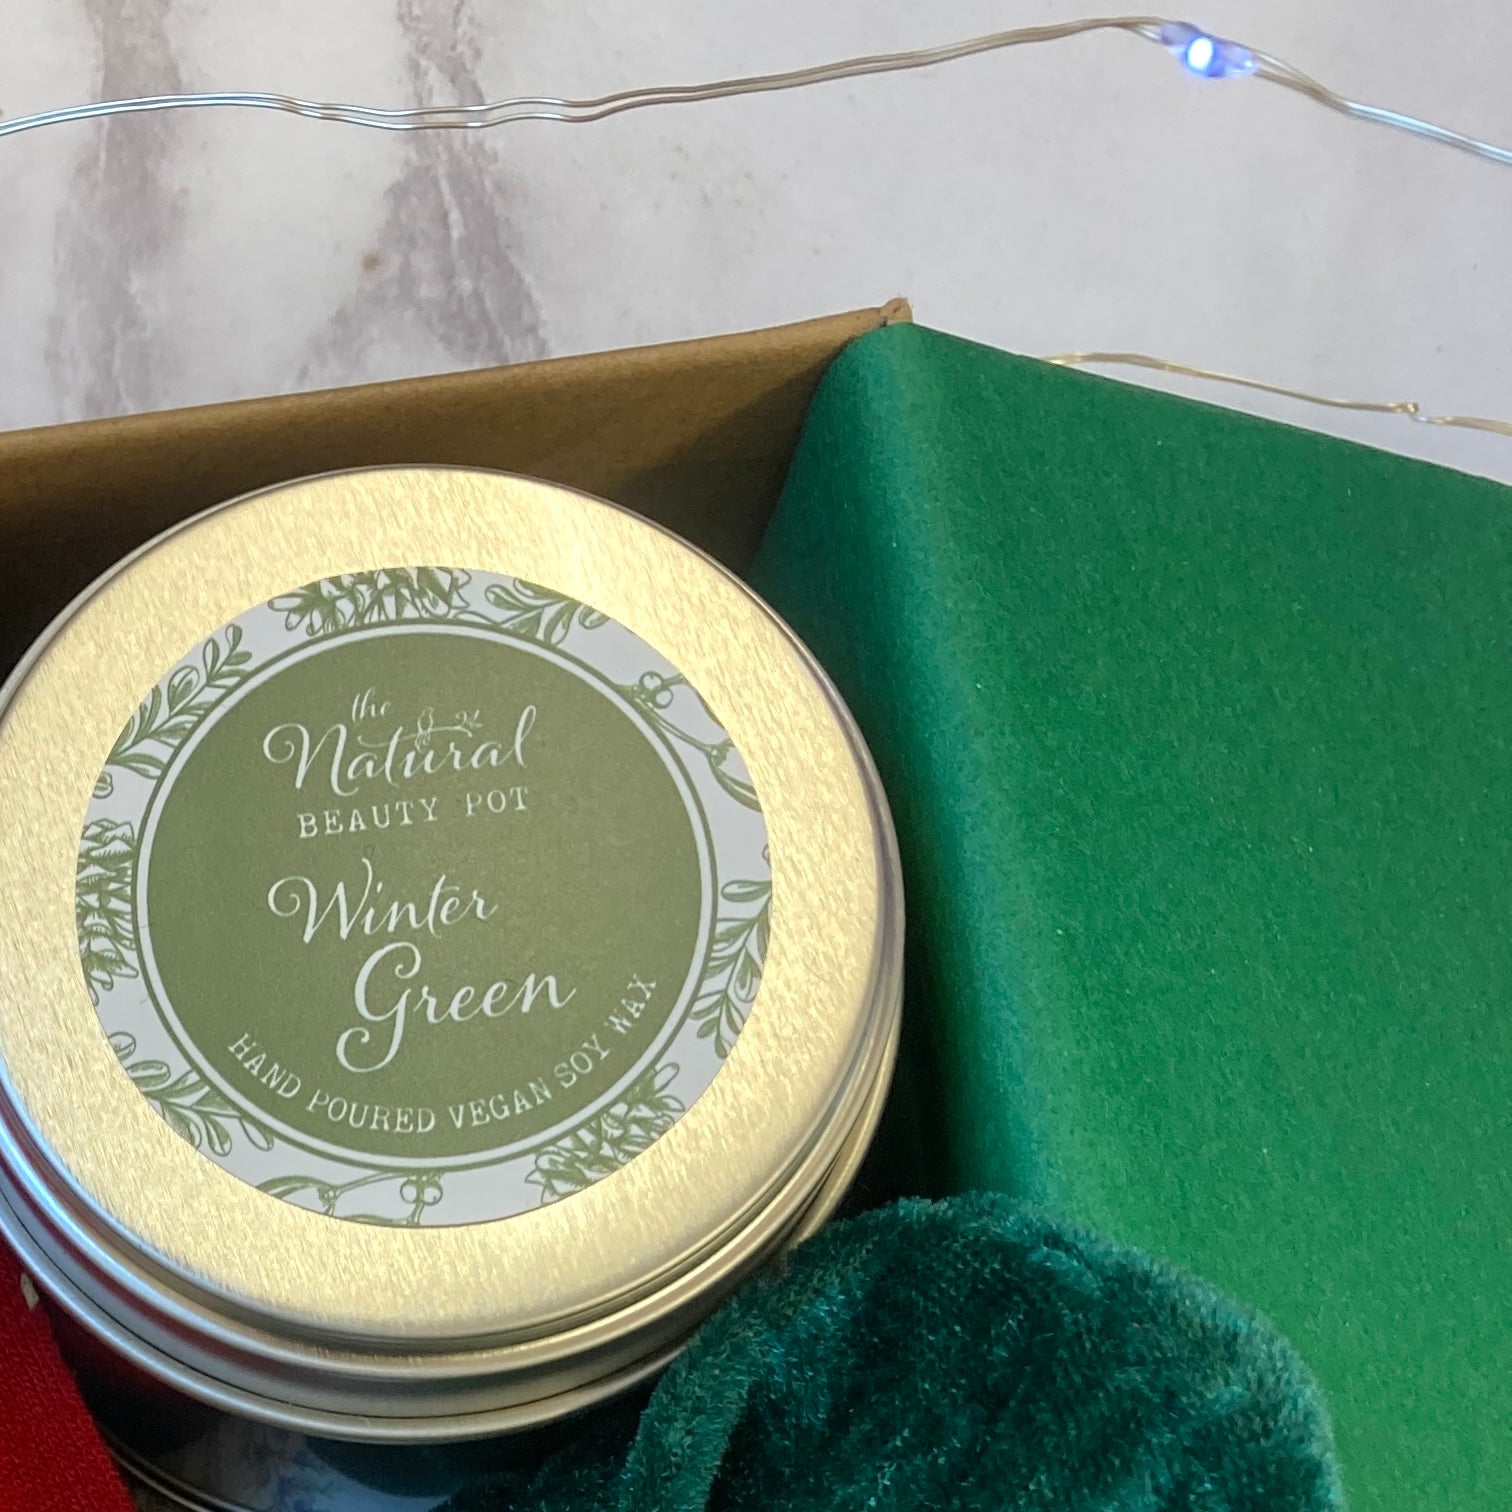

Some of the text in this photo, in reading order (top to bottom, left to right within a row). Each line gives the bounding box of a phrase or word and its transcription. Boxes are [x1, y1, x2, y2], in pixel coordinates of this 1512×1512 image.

[351, 686, 392, 722] the
[262, 704, 537, 797] Natural
[297, 786, 529, 838] BEAUTY POT
[267, 857, 499, 944] Winter
[335, 941, 577, 1073] Green
[227, 973, 657, 1134] HAND POURED VEGAN SOY WAX
